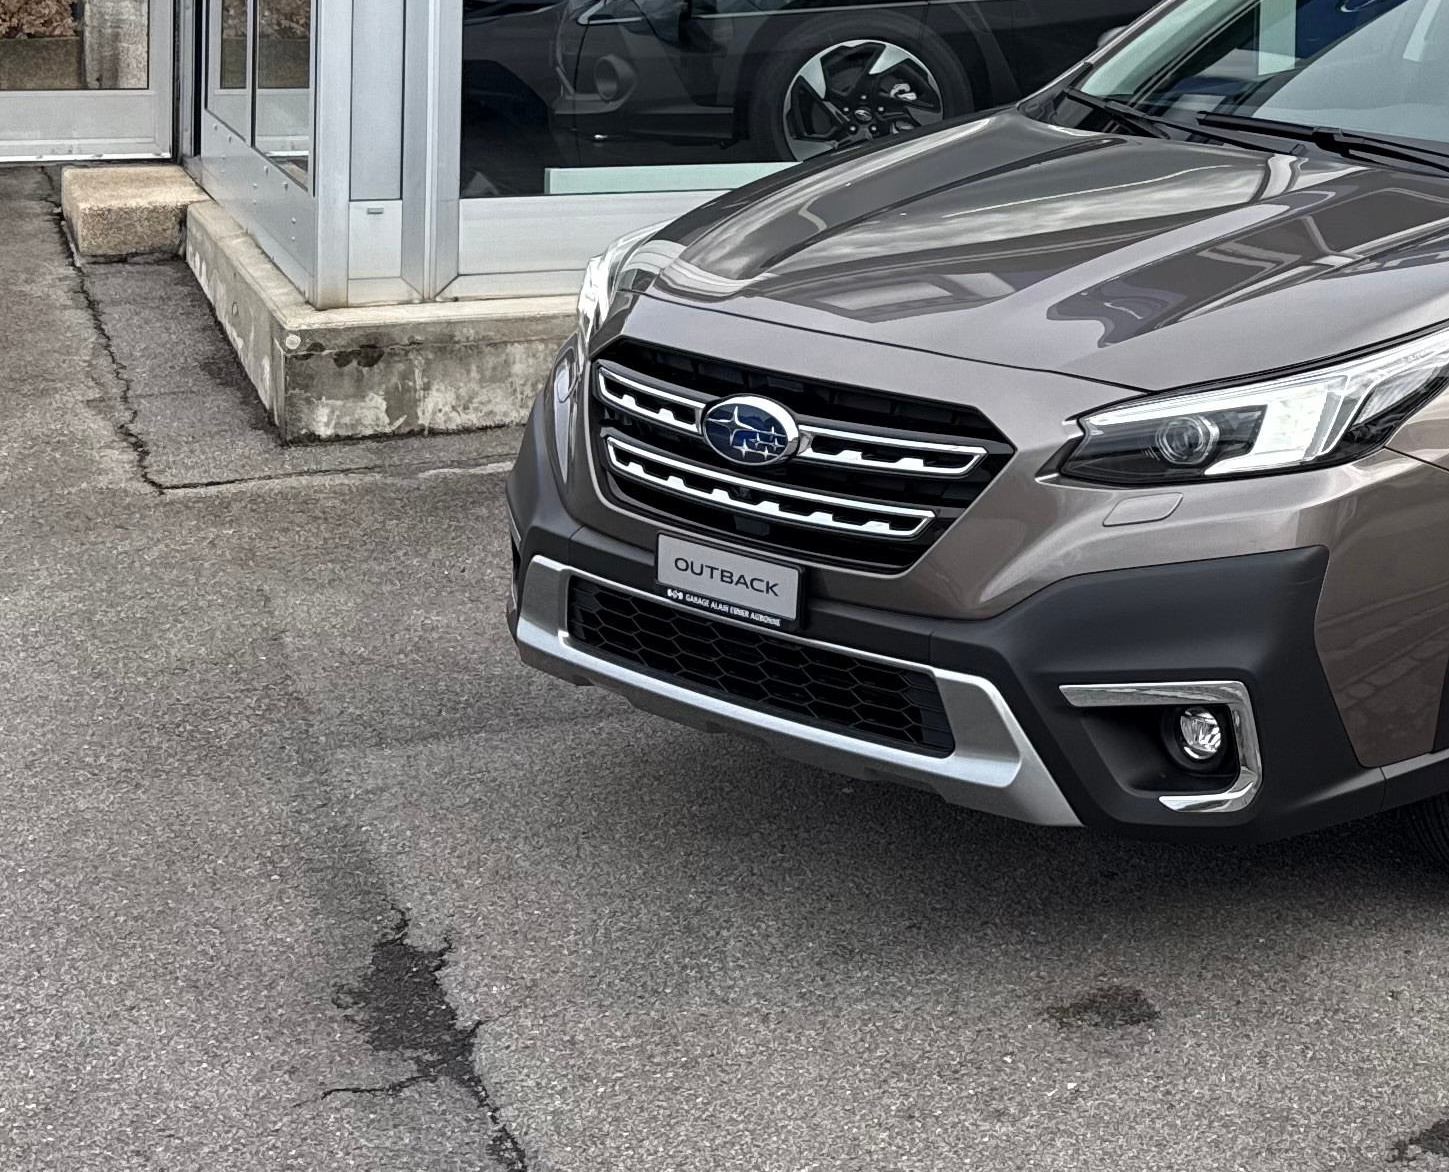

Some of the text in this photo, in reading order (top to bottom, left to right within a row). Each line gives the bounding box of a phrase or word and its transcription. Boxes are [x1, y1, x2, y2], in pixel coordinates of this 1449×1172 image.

[674, 556, 780, 598] OUTBACK
[685, 593, 710, 608] GARAGE
[710, 601, 729, 614] ALAIN
